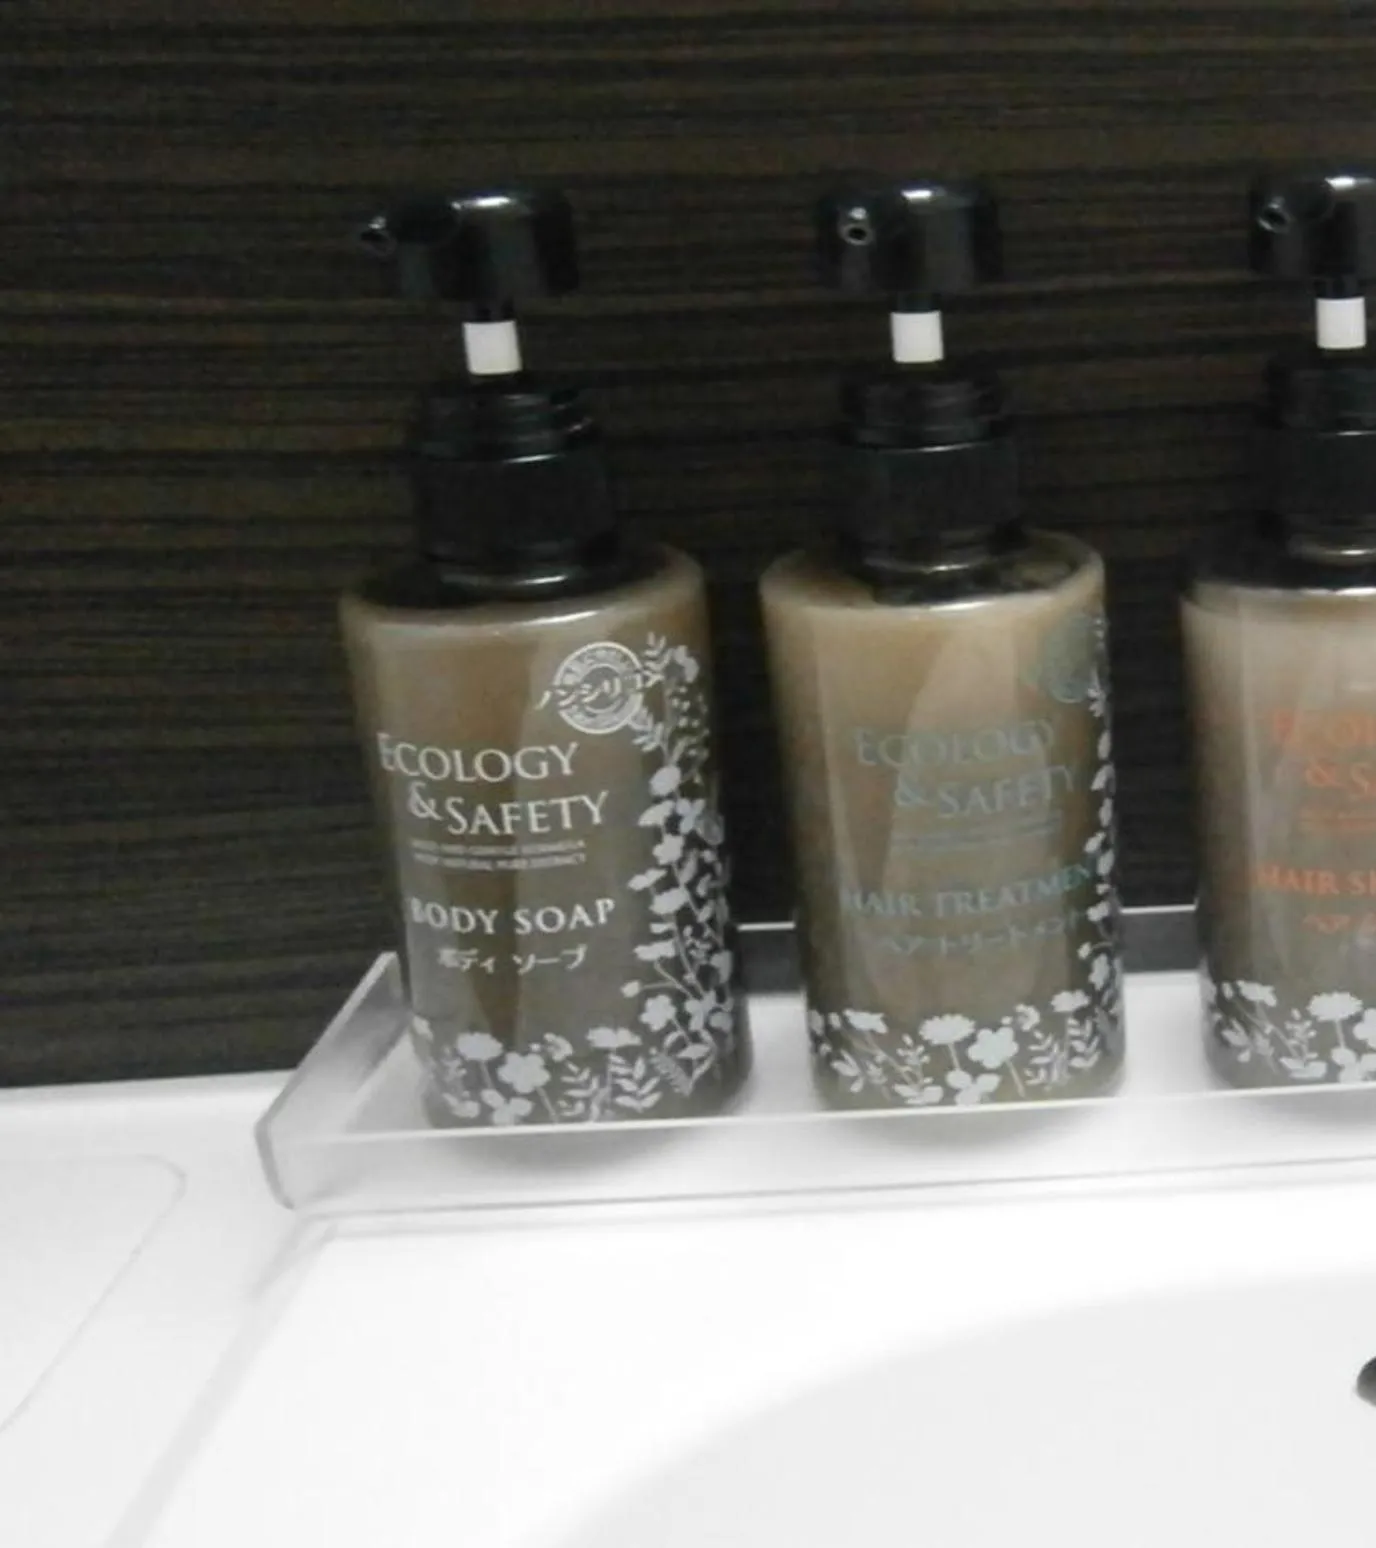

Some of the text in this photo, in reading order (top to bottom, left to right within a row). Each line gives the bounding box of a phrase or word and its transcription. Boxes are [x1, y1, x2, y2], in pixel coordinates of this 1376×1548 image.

[376, 732, 579, 782] ECOLOGY
[840, 862, 1094, 918] HAIR TREATMEN
[1256, 860, 1340, 896] HAIR
[411, 897, 615, 935] BODY SOAP
[512, 943, 587, 975] ソープ
